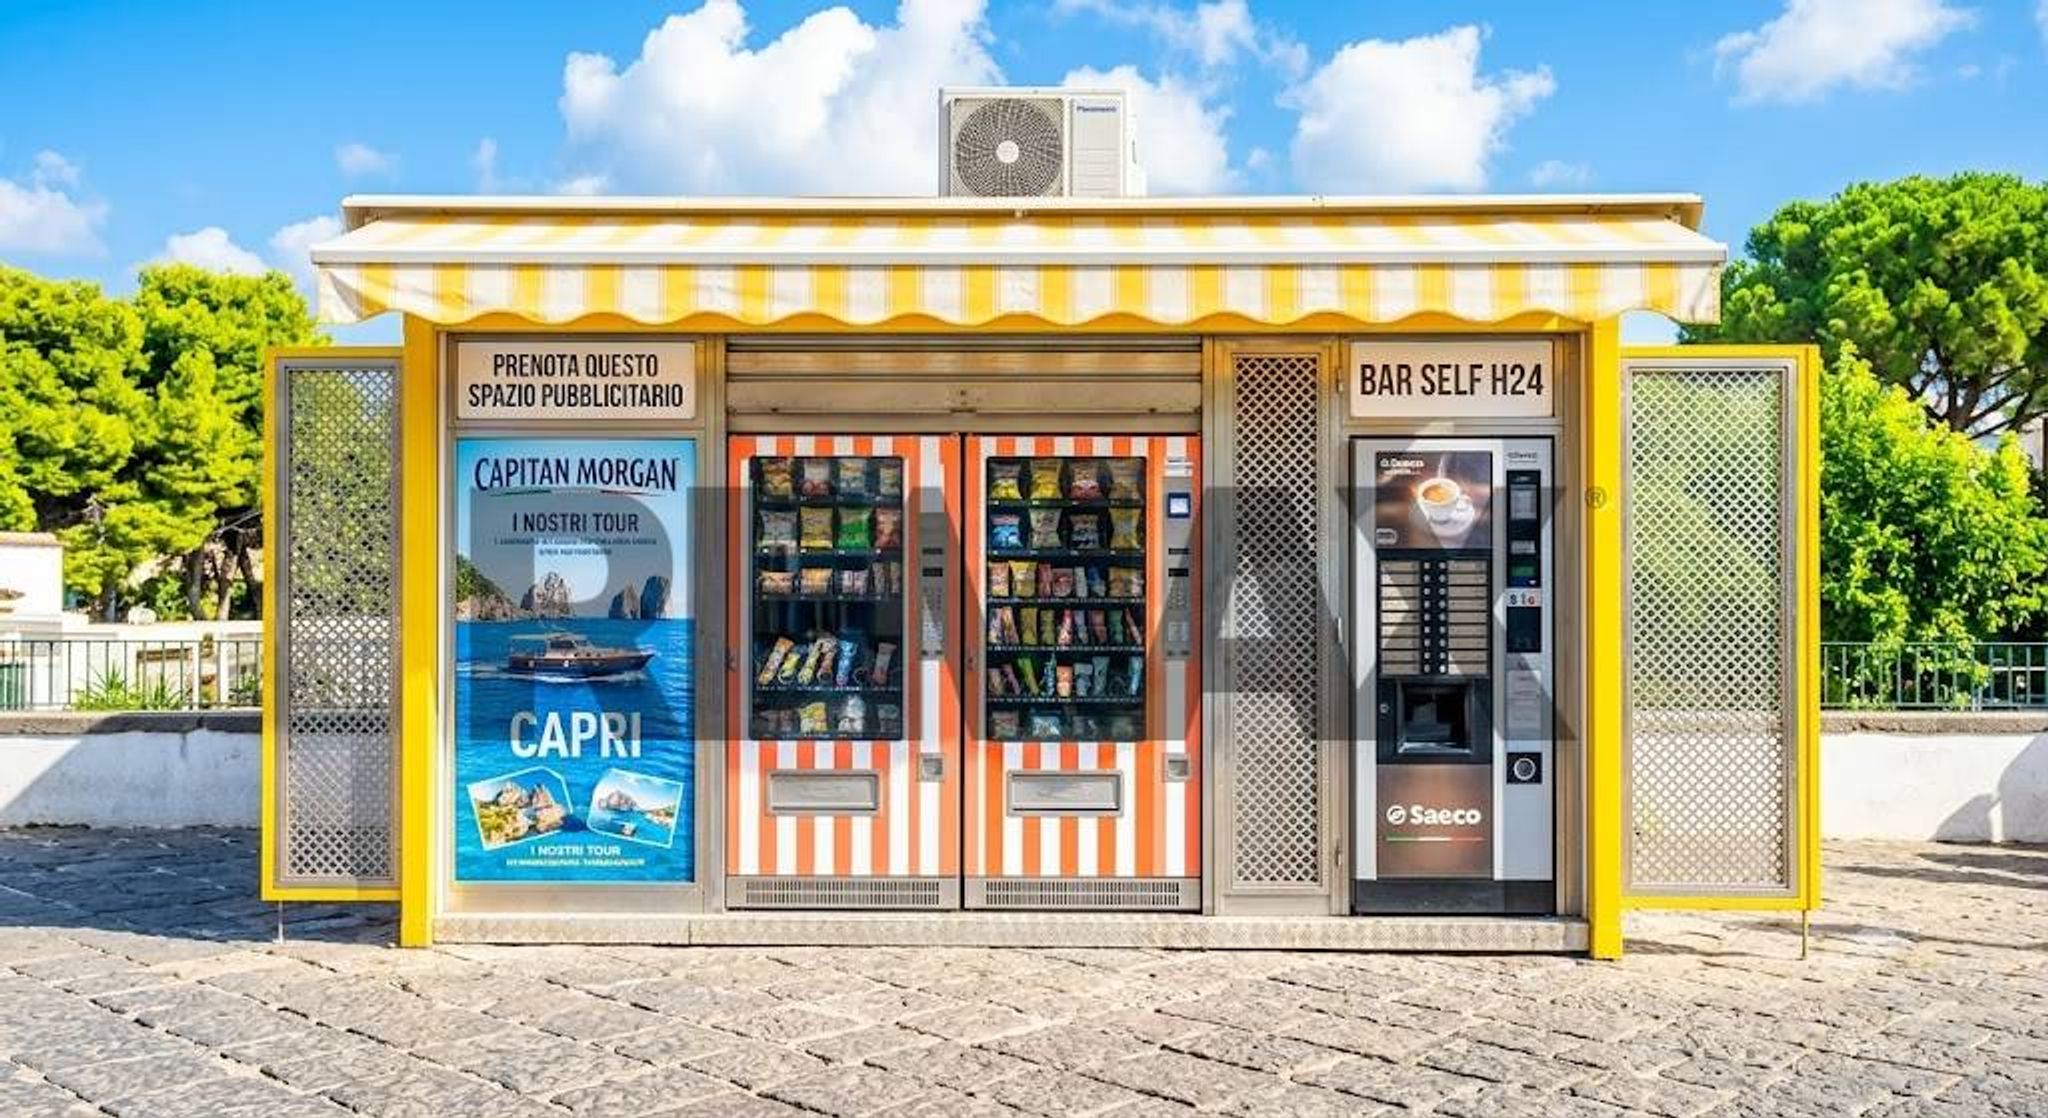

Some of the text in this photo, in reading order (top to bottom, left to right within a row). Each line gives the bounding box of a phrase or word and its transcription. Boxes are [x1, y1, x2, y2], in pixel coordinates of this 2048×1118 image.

[493, 353, 658, 378] PRENOTA QUESTO
[1360, 363, 1544, 396] BAR SELF H24
[468, 383, 684, 408] SPAZIO PUBBLICITARIO
[474, 457, 676, 492] CAPITAN MORGAN
[512, 512, 640, 533] I NOSTRI TOUR
[510, 711, 642, 759] CAPRI
[1409, 804, 1482, 826] Saeco
[538, 844, 583, 856] NOSTRI
[588, 844, 622, 856] TOUR
